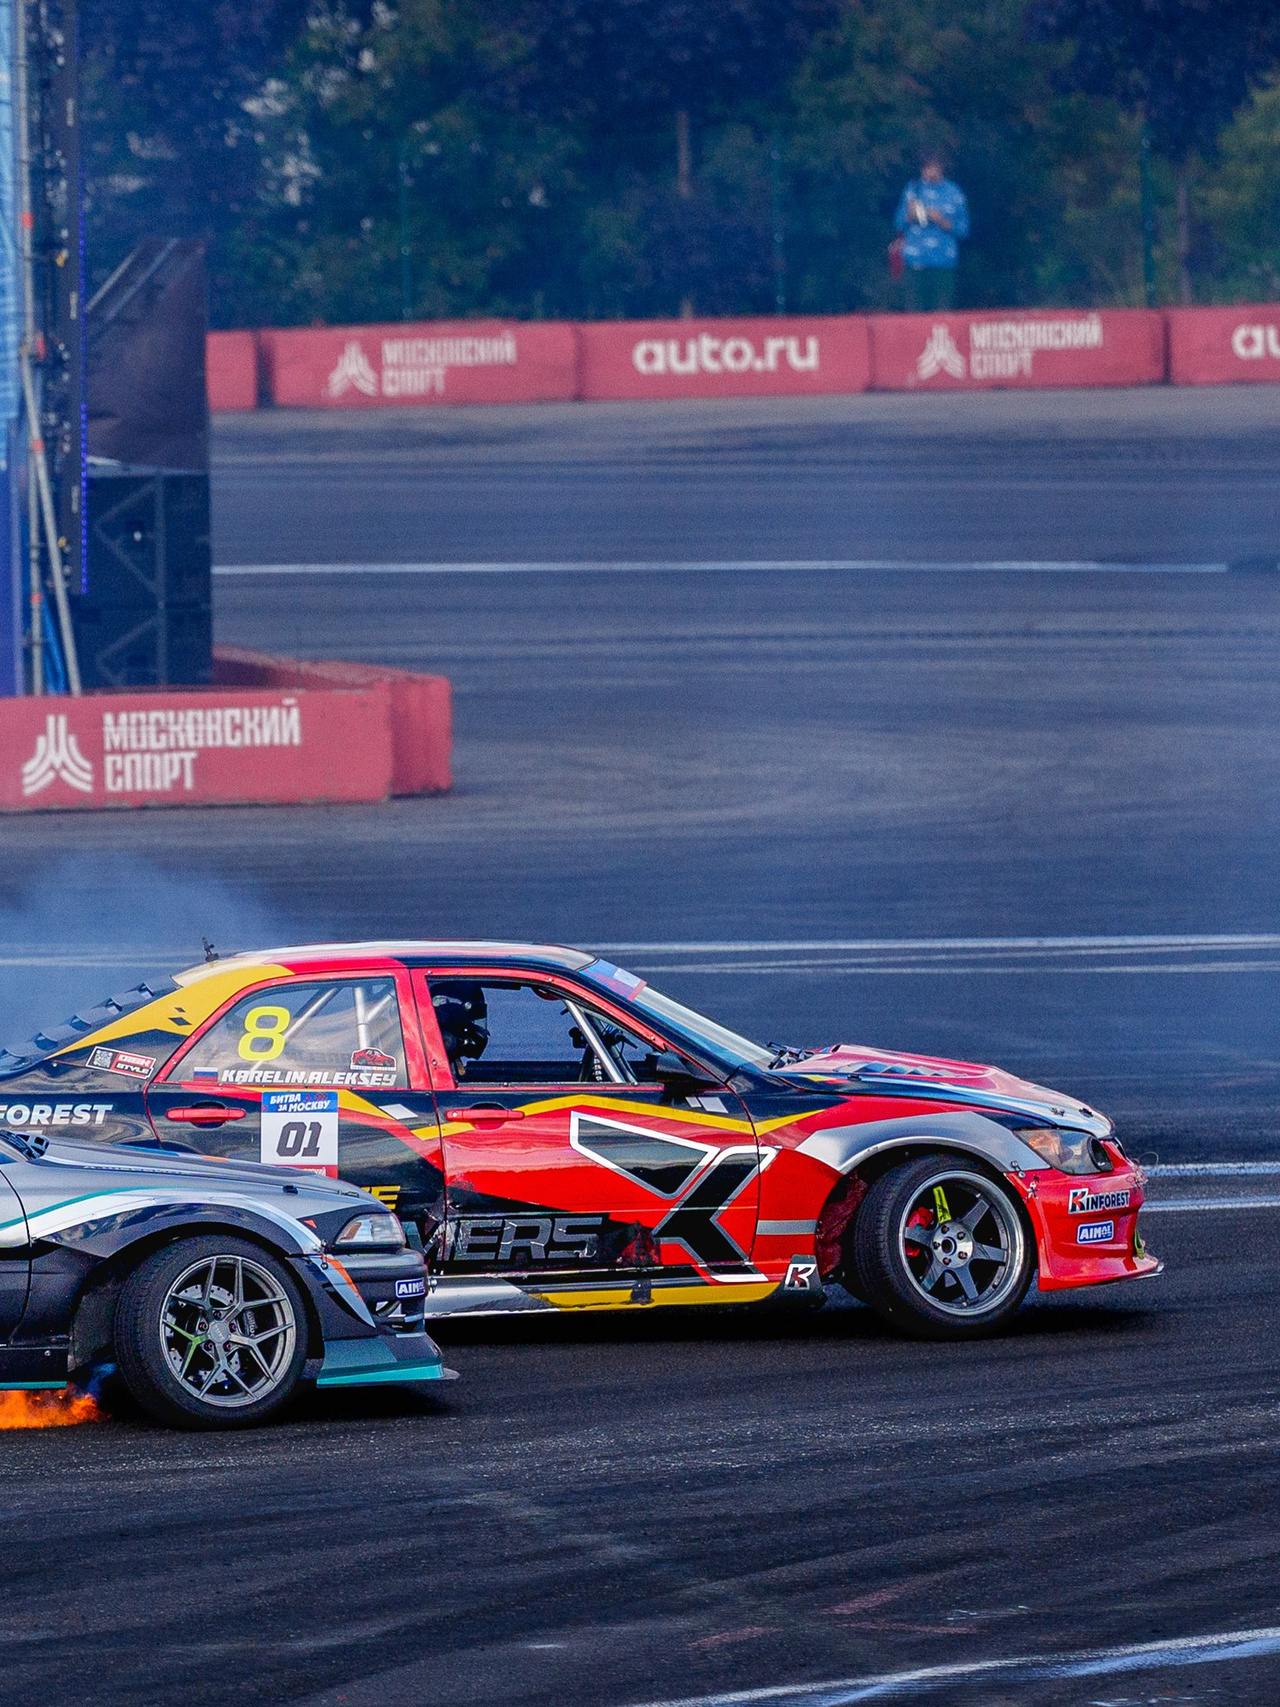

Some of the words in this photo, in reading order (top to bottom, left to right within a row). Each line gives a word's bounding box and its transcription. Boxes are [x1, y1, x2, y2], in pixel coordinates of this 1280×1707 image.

[632, 332, 819, 374] auto.ru
[103, 697, 301, 751] МОСКОВСКИЙ
[104, 750, 198, 792] СПОРТ
[238, 1005, 291, 1061] 8
[270, 1093, 301, 1105] БИТВА
[277, 1104, 288, 1112] ЗА
[288, 1100, 330, 1112] МОСКВУ
[276, 1121, 322, 1157] 01
[1069, 1189, 1129, 1213] KINFOREST
